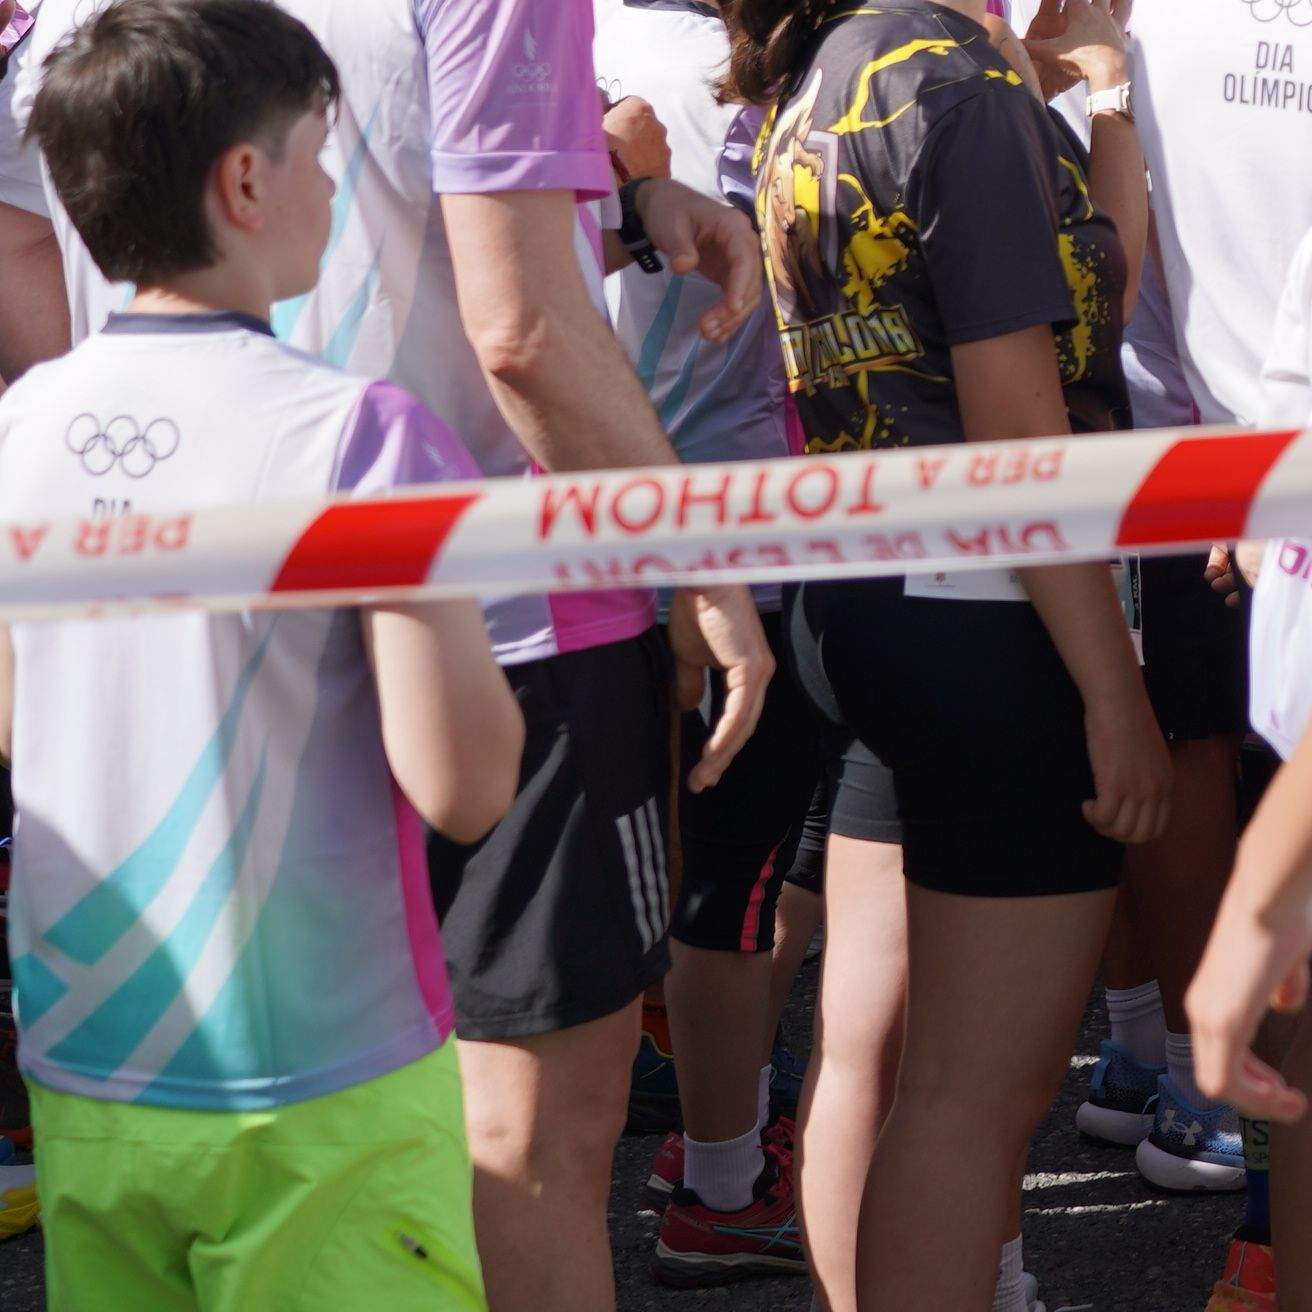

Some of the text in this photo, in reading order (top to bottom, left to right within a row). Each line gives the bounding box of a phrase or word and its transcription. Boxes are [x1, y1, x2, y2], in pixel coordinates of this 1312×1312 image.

[1255, 40, 1295, 73] DIA
[537, 446, 1068, 540] PER A TOTHOM
[8, 510, 196, 563] PER A
